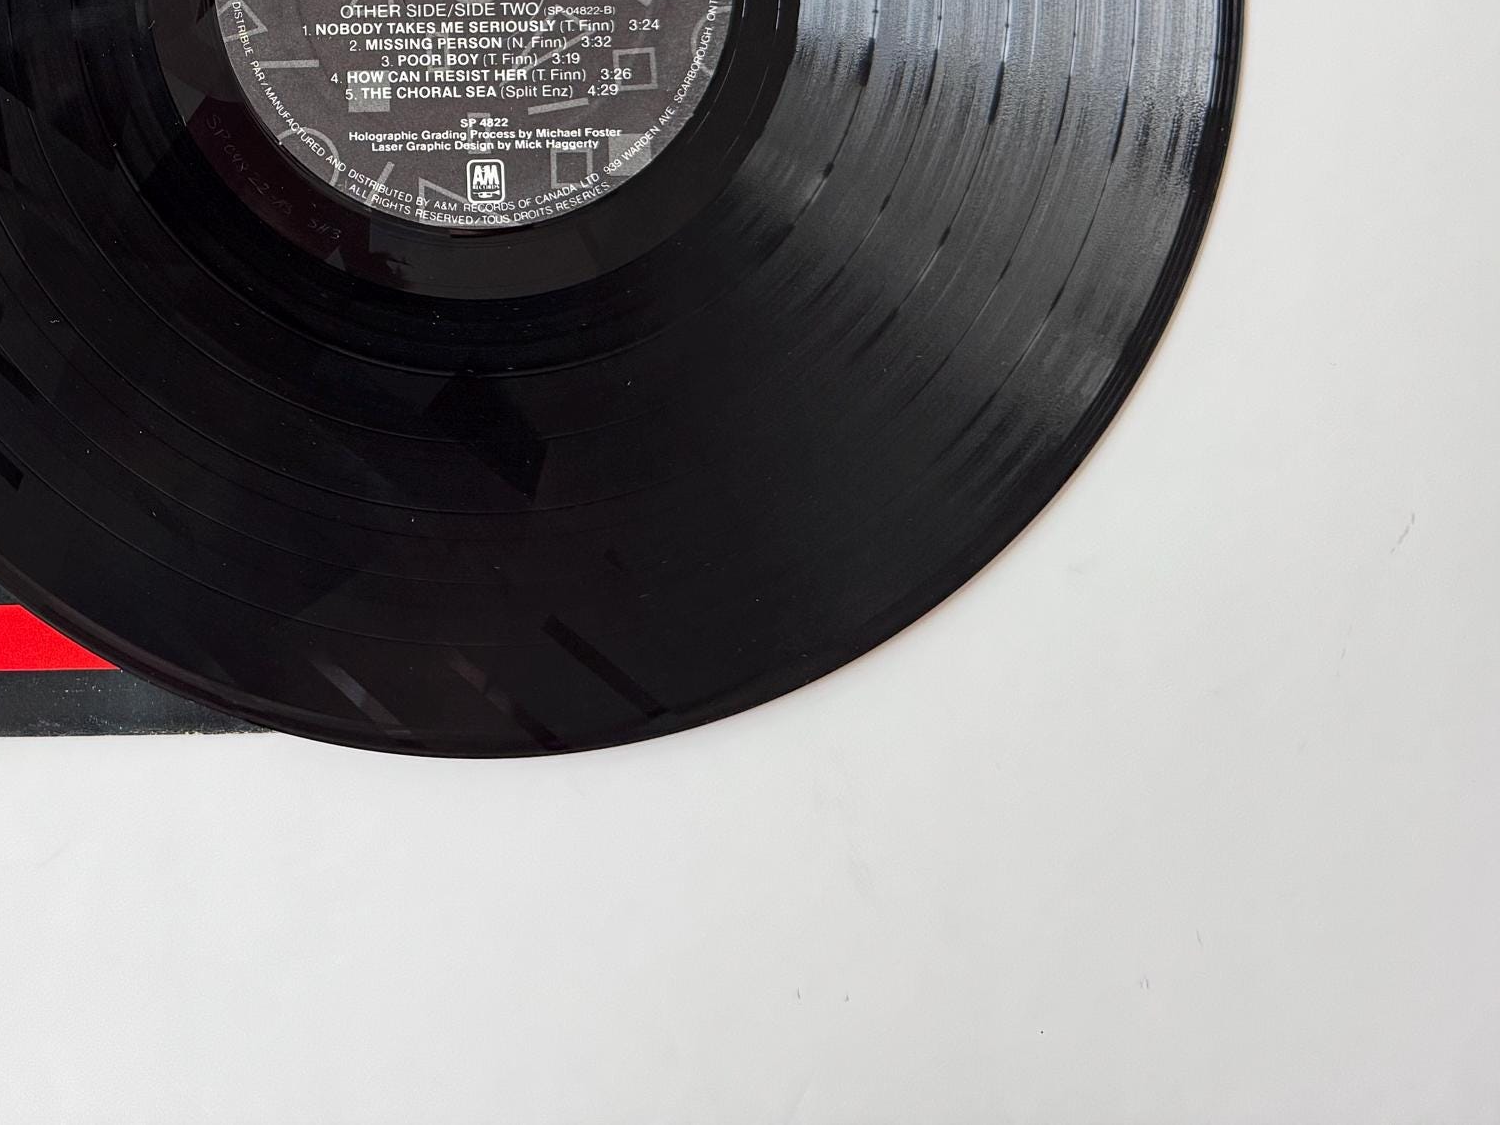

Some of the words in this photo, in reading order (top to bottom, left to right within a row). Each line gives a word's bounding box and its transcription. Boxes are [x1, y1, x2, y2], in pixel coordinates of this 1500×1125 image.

[340, 4, 400, 19] OTHER
[406, 2, 496, 18] SIDE/SIDE
[500, 2, 539, 16] TWO
[315, 23, 382, 36] NOBODY
[387, 22, 436, 34] TAKES
[440, 21, 464, 33] ME
[469, 20, 556, 33] SERIOUSLY
[559, 19, 575, 33] (T.
[579, 19, 615, 33] Finn)
[628, 18, 660, 31] 3:24
[365, 38, 433, 50] MISSING
[437, 37, 502, 49] PERSON
[506, 36, 527, 50] (N.
[531, 36, 567, 49] Finn)
[581, 35, 612, 47] 3:32
[398, 54, 442, 66] POOR
[446, 53, 478, 65] BOY
[483, 53, 498, 67] (T.
[502, 52, 538, 66] Finn)
[551, 52, 580, 64] 3:19
[347, 71, 384, 84] HOW
[388, 70, 420, 83] CAN
[434, 69, 490, 82] RESIST
[494, 69, 527, 81] HER
[531, 68, 547, 82] (T.
[550, 68, 587, 81] Finn)
[600, 68, 632, 80] 3:26
[361, 87, 392, 99] THE
[396, 86, 461, 99] CHORAL
[465, 85, 497, 98] SEA
[500, 85, 537, 99] (Split
[542, 84, 573, 98] Enz)
[587, 83, 618, 96] 4:29
[460, 119, 476, 128] SP
[479, 118, 509, 127] 4822
[349, 131, 418, 143] Holographic
[421, 130, 467, 141] Grading
[470, 129, 515, 139] Process
[518, 129, 532, 140] by
[536, 128, 581, 138] Michael
[584, 127, 622, 137] Foster
[371, 142, 402, 151] Laser
[406, 141, 451, 153] Graphic
[454, 141, 494, 152] Design
[497, 140, 512, 151] by
[515, 139, 542, 149] Mick
[546, 138, 599, 150] Haggerty
[325, 152, 346, 172] AND
[348, 170, 413, 203] DISTRIBUTED
[416, 194, 430, 207] BY
[434, 201, 457, 211] A&M
[463, 201, 515, 213] RECORDS
[518, 198, 532, 209] OF
[535, 184, 577, 204] CANADA
[580, 173, 600, 189] LTD
[603, 159, 622, 175] 939
[621, 125, 660, 161] WARDEN
[349, 184, 367, 200] ALL
[371, 196, 411, 216] RIGHTS
[514, 206, 554, 223] DROITS
[556, 182, 610, 211] RESERVES
